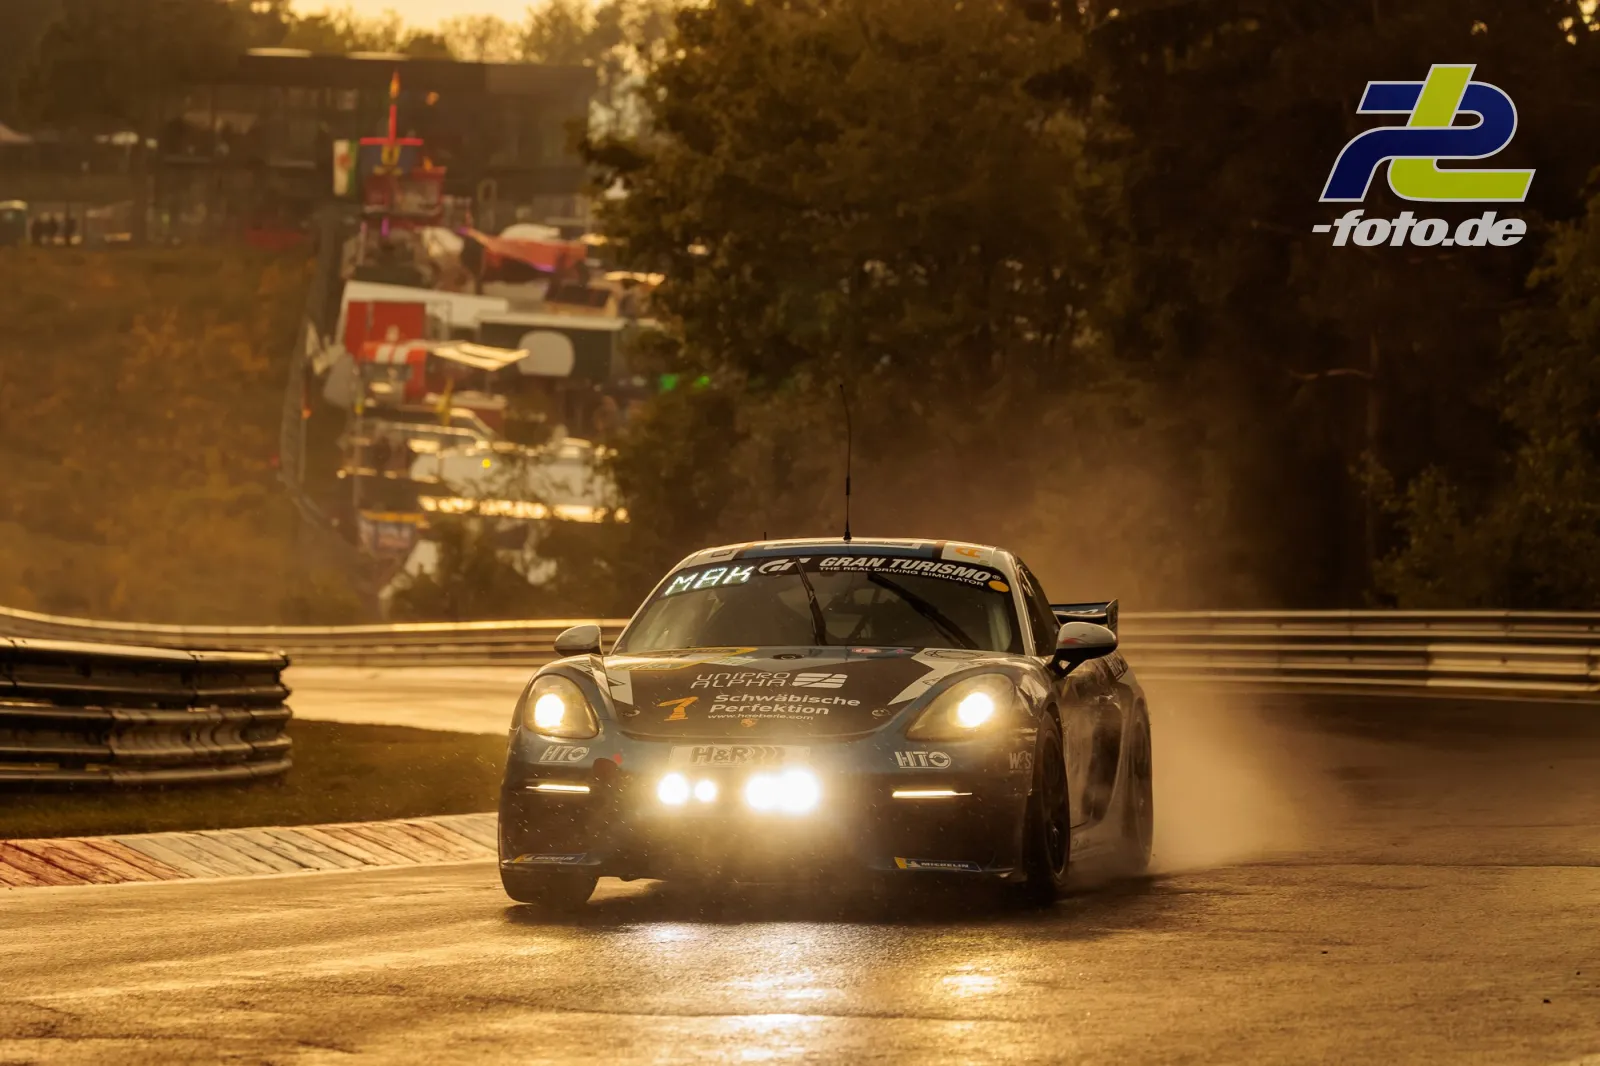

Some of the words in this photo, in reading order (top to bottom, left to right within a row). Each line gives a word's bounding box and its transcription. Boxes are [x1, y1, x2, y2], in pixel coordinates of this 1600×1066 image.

[819, 557, 887, 567] GRAN
[874, 567, 918, 575] DRIVING
[921, 571, 985, 586] SIMULATOR
[690, 679, 786, 689] ALPHA
[714, 694, 860, 707] Schwäbische
[709, 703, 829, 715] Perfektion
[690, 746, 750, 763] H&R
